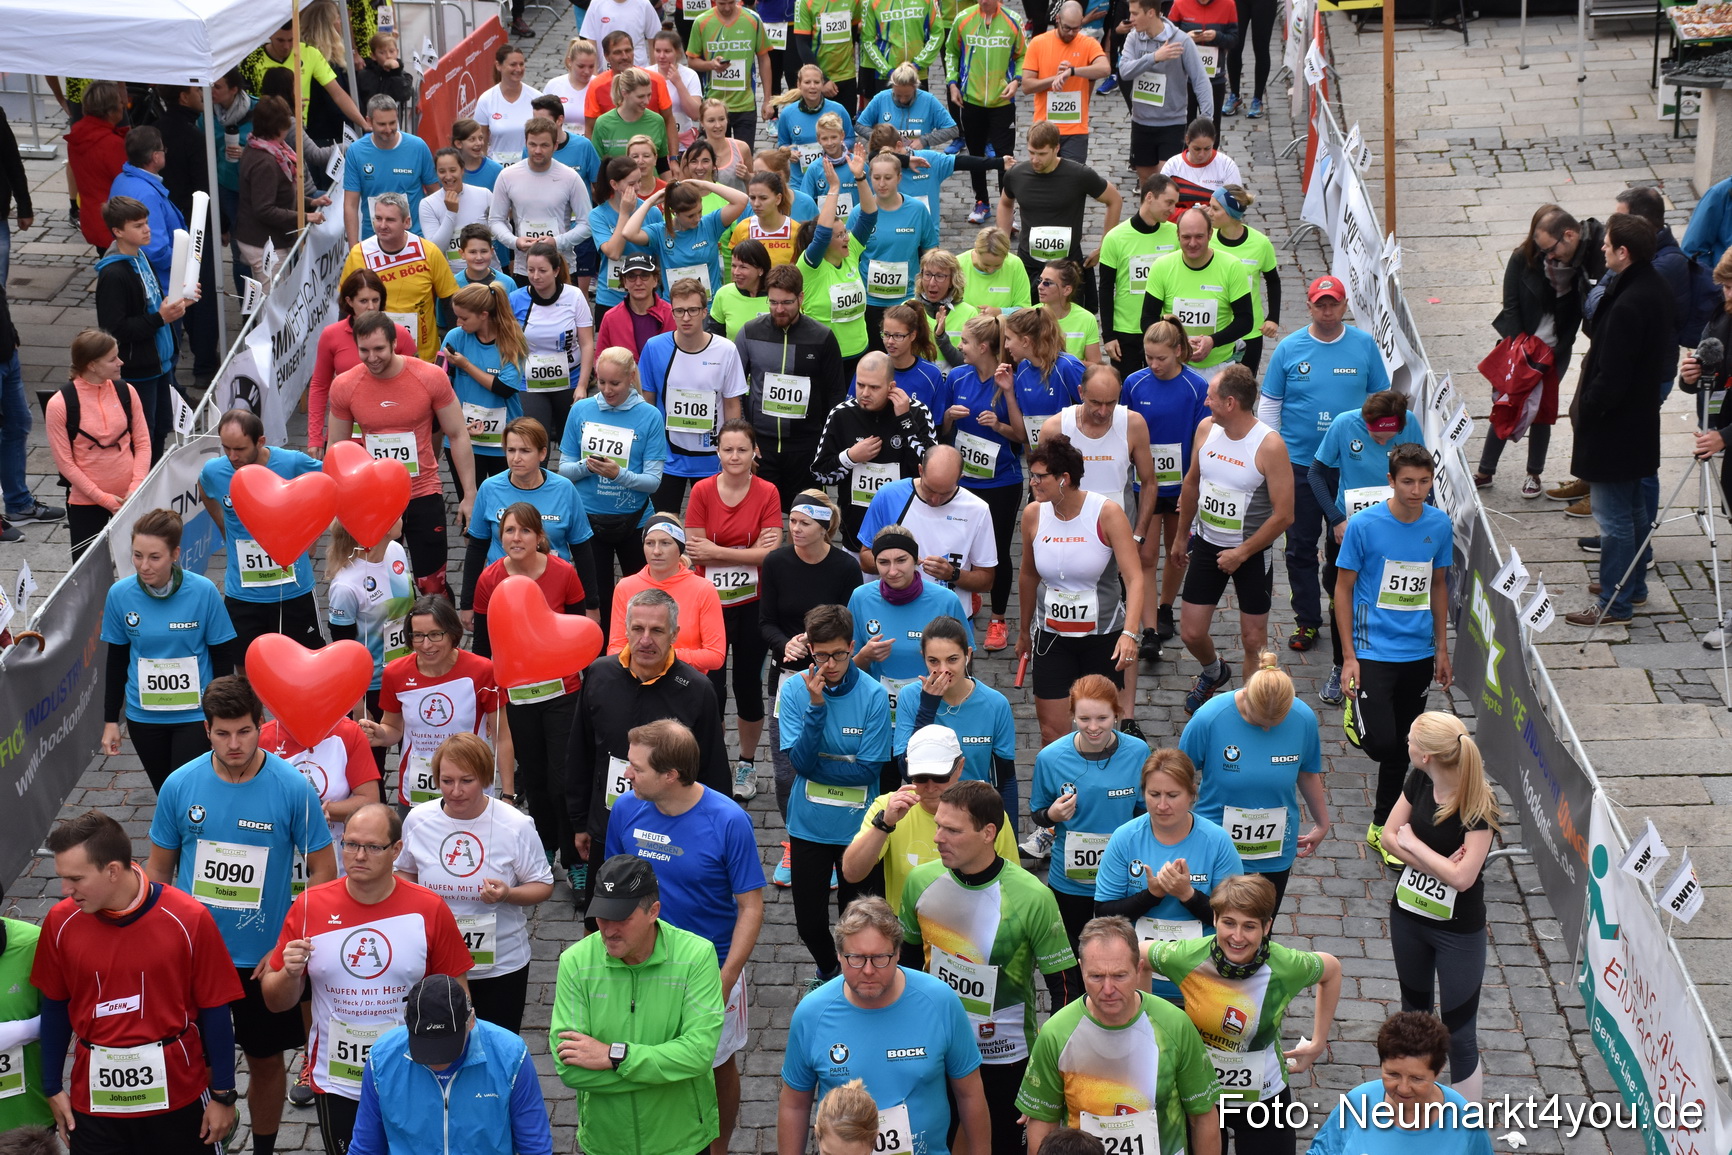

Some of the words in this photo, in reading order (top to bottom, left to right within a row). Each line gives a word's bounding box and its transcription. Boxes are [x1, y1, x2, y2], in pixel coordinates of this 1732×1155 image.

[881, 8, 925, 22] BOCK
[826, 20, 847, 32] 5230
[707, 40, 752, 52] BOCK
[966, 35, 1010, 48] BOCK
[1138, 81, 1161, 94] 5227
[1052, 101, 1077, 112] 5226
[195, 229, 204, 253] swn
[768, 241, 791, 249] BÖGL
[1035, 238, 1065, 250] 5046
[379, 271, 398, 284] AX
[399, 264, 431, 279] BÖGL
[873, 272, 902, 286] 5037
[837, 291, 863, 309] 5040
[1178, 311, 1211, 325] 5210
[531, 364, 563, 379] 5066
[769, 386, 803, 402] 5010
[1435, 387, 1448, 410] swn
[673, 402, 708, 417] 5108
[1318, 412, 1331, 421] 18.
[178, 404, 187, 430] swn
[1450, 418, 1467, 441] swn
[375, 447, 410, 460] 5179
[588, 437, 624, 456] 5178
[960, 445, 990, 466] 5166
[1217, 454, 1246, 468] KLEBL
[1204, 496, 1236, 517] 5013
[712, 571, 750, 588] 5122
[1389, 574, 1428, 592] 5135
[1503, 571, 1517, 592] sw
[1051, 603, 1089, 620] 8017
[1530, 598, 1551, 624] swn
[169, 622, 198, 631] BOCK
[147, 673, 191, 691] 5003
[963, 736, 992, 744] BOCK
[1271, 755, 1299, 764] BOCK
[827, 788, 844, 796] Klara
[1108, 787, 1135, 797] BOCK
[238, 820, 273, 831] BOCK
[1230, 823, 1278, 841] 5147
[641, 832, 665, 843] HEUTE
[650, 842, 679, 854] MORGEN
[1237, 844, 1268, 853] Stephanie
[637, 849, 671, 862] BEWEGEN
[204, 859, 255, 885] 5090
[458, 885, 474, 893] MIT
[1406, 867, 1449, 901] 5025
[215, 886, 237, 897] Tobias
[1671, 880, 1696, 911] swn
[1414, 896, 1428, 907] Lisa
[938, 966, 985, 998] 5500
[325, 983, 357, 996] LAUFEN
[362, 987, 379, 996] MIT
[384, 984, 407, 996] HERZ
[108, 1002, 128, 1012] DEHN
[334, 1006, 398, 1017] Leistungsdiagnostik
[886, 1048, 926, 1060] BOCK
[99, 1066, 154, 1089] 5083
[109, 1093, 147, 1102] Johannes
